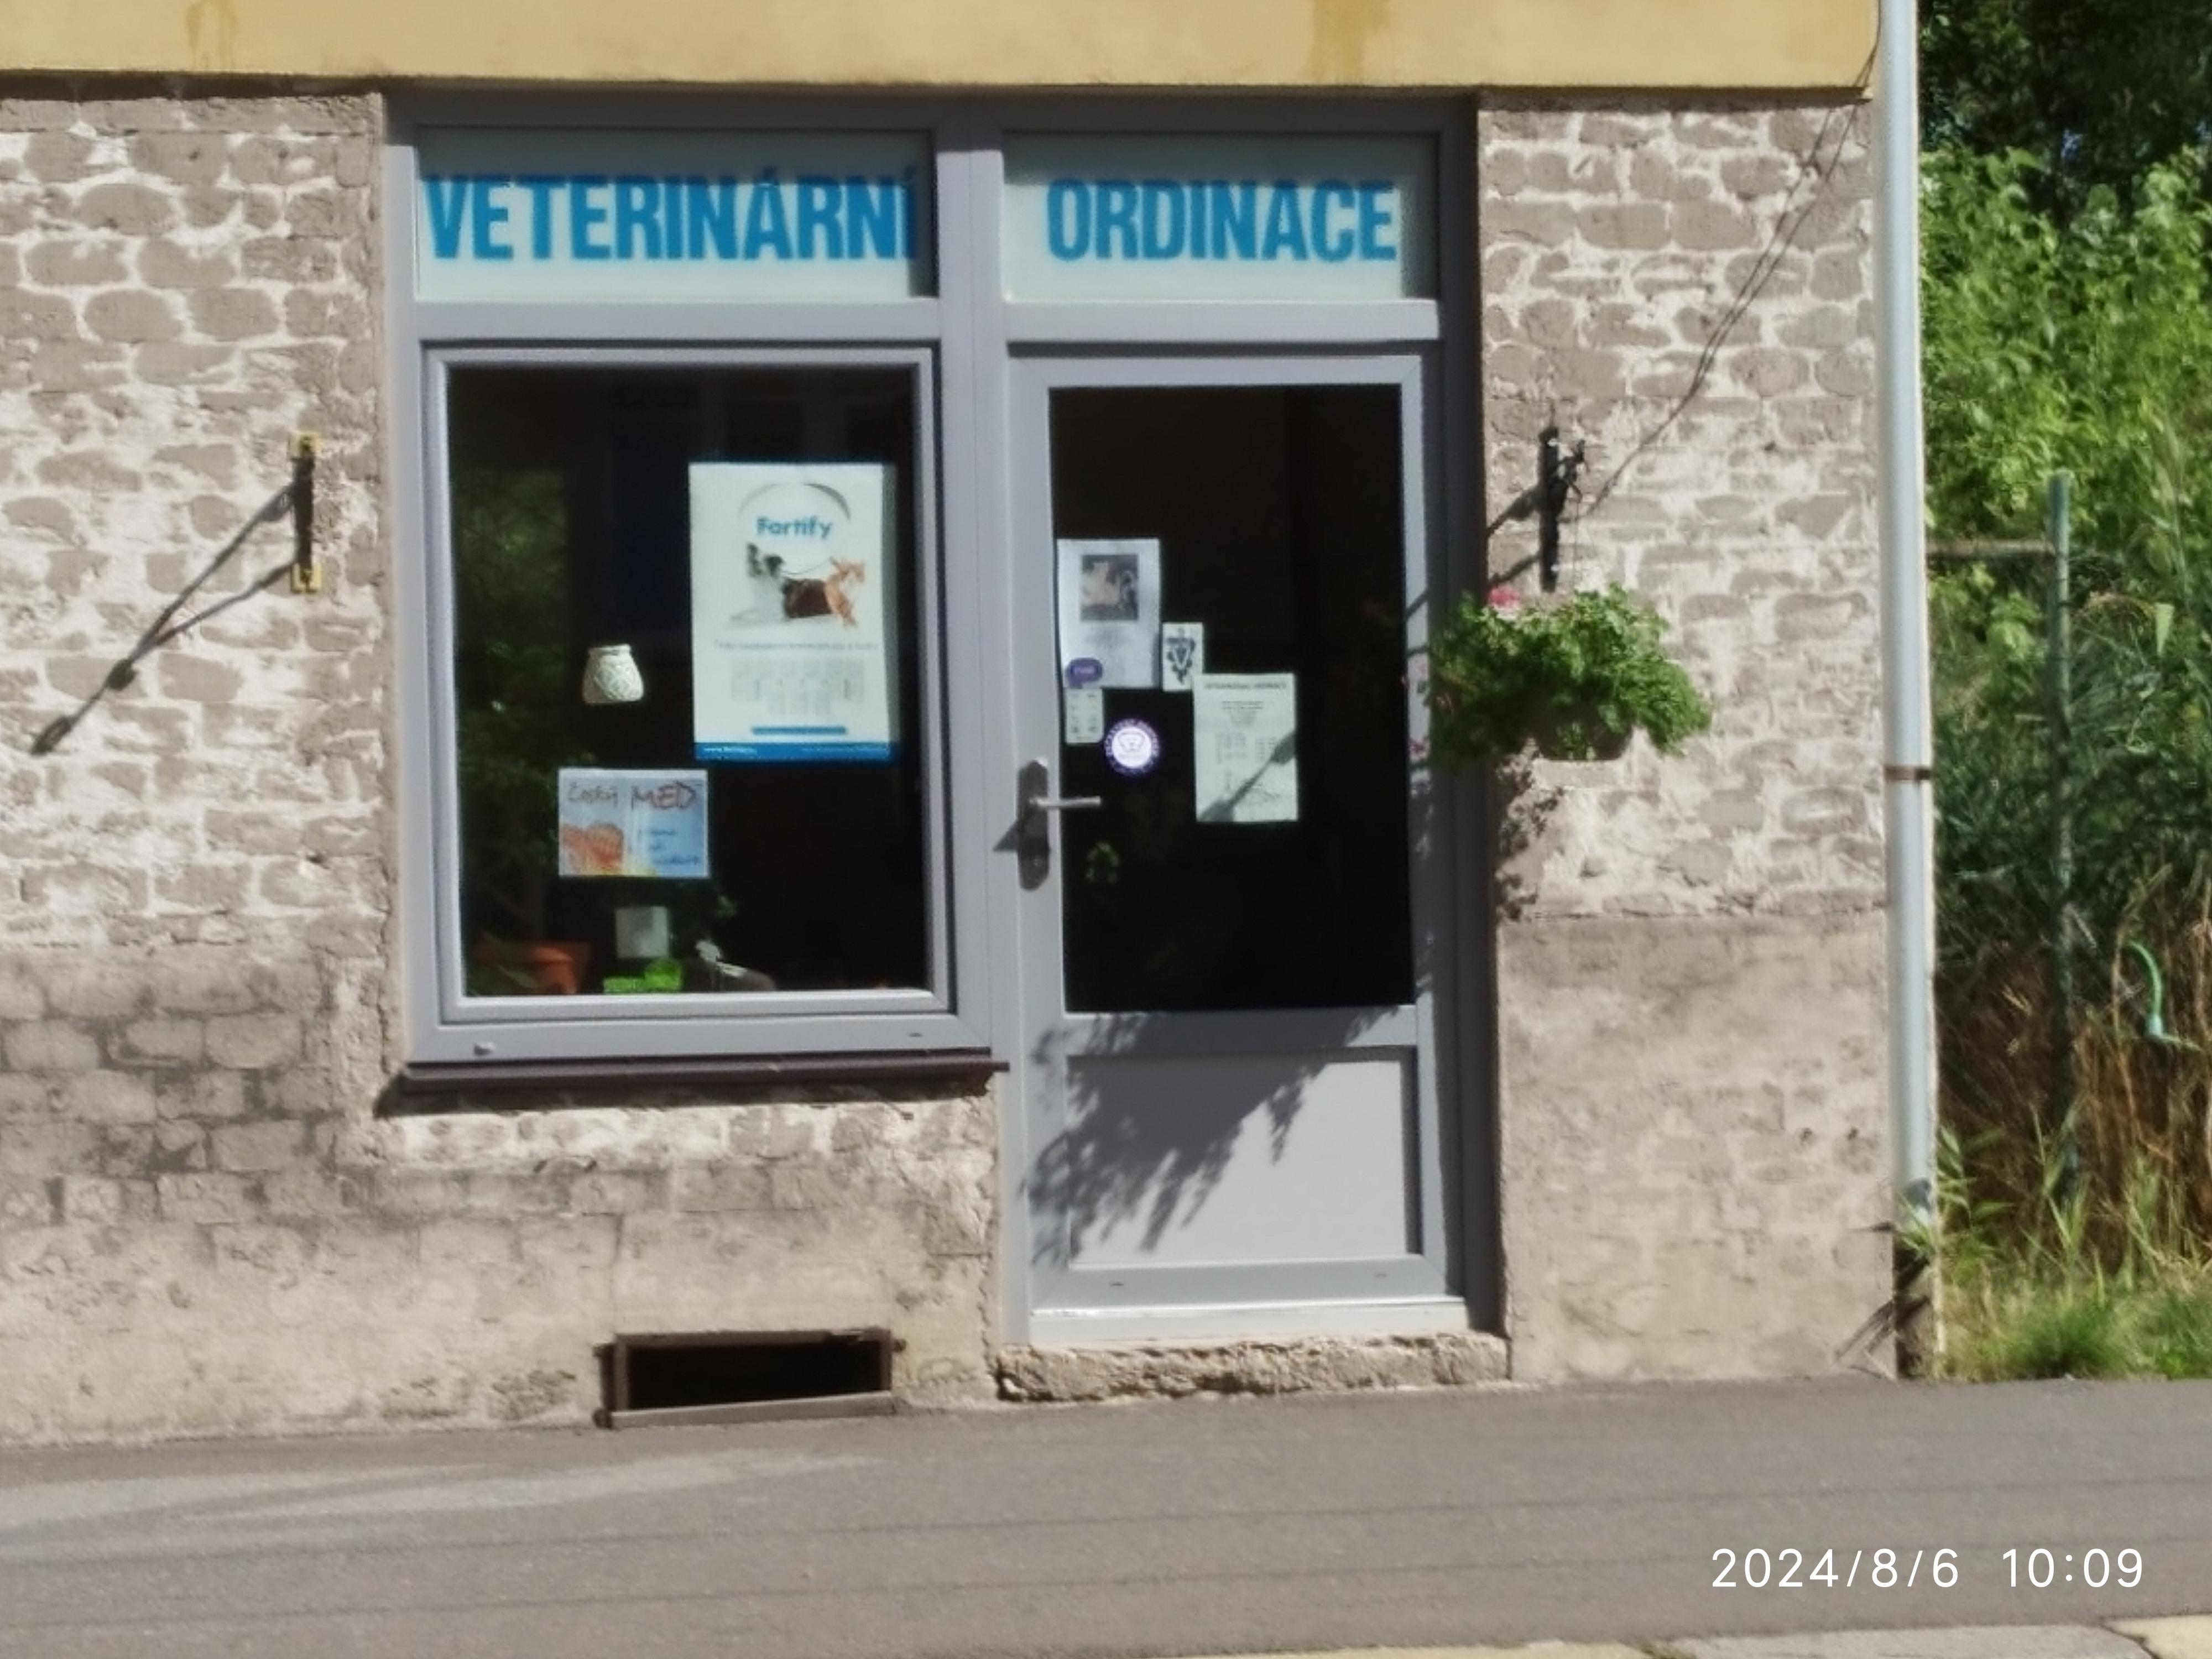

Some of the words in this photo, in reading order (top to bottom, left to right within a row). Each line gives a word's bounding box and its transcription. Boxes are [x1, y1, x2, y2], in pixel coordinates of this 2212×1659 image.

[419, 165, 917, 261] VETERINÁRNÍ
[1046, 177, 1397, 262] ORDINACE
[756, 515, 834, 540] Fortify
